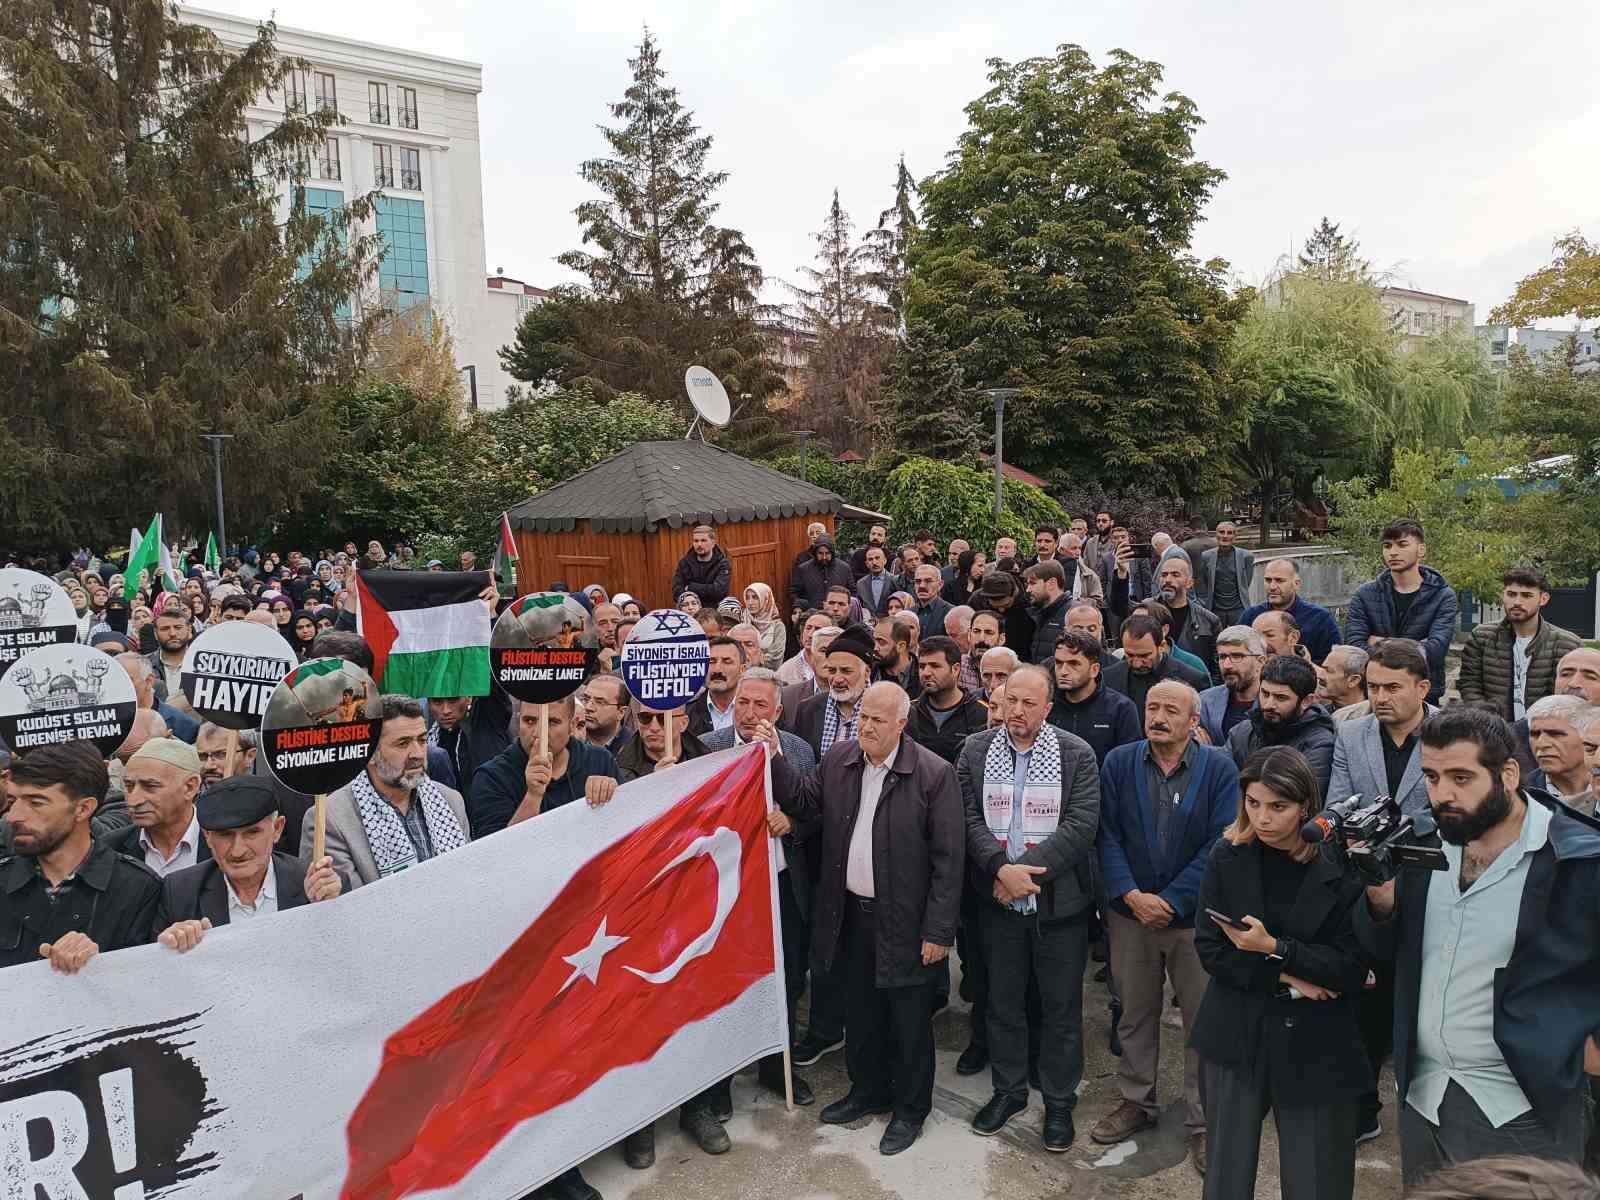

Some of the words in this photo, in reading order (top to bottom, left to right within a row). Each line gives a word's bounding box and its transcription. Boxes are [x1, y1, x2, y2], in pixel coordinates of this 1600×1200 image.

[16, 630, 57, 645] SELAM
[501, 649, 548, 666] FİLİSTİNE
[549, 651, 586, 665] DESTEK
[627, 644, 675, 661] SİYONİST
[677, 643, 710, 659] İSRAİL
[196, 652, 286, 680] SOYKIRIMA
[500, 666, 555, 681] SİYONİZME
[555, 668, 585, 681] LANET
[628, 661, 706, 680] FİLİSTİN'DEN
[641, 677, 695, 699] DEFOL
[16, 714, 72, 732] KUDÜS'E
[73, 708, 117, 725] SELAM
[15, 728, 76, 748] DİRENİŞE
[77, 723, 122, 740] DEVAM
[276, 728, 329, 750] FİLİSTİNE
[330, 723, 370, 743] DESTEK
[276, 747, 336, 770] SİYONİZME
[338, 743, 370, 761] LANET
